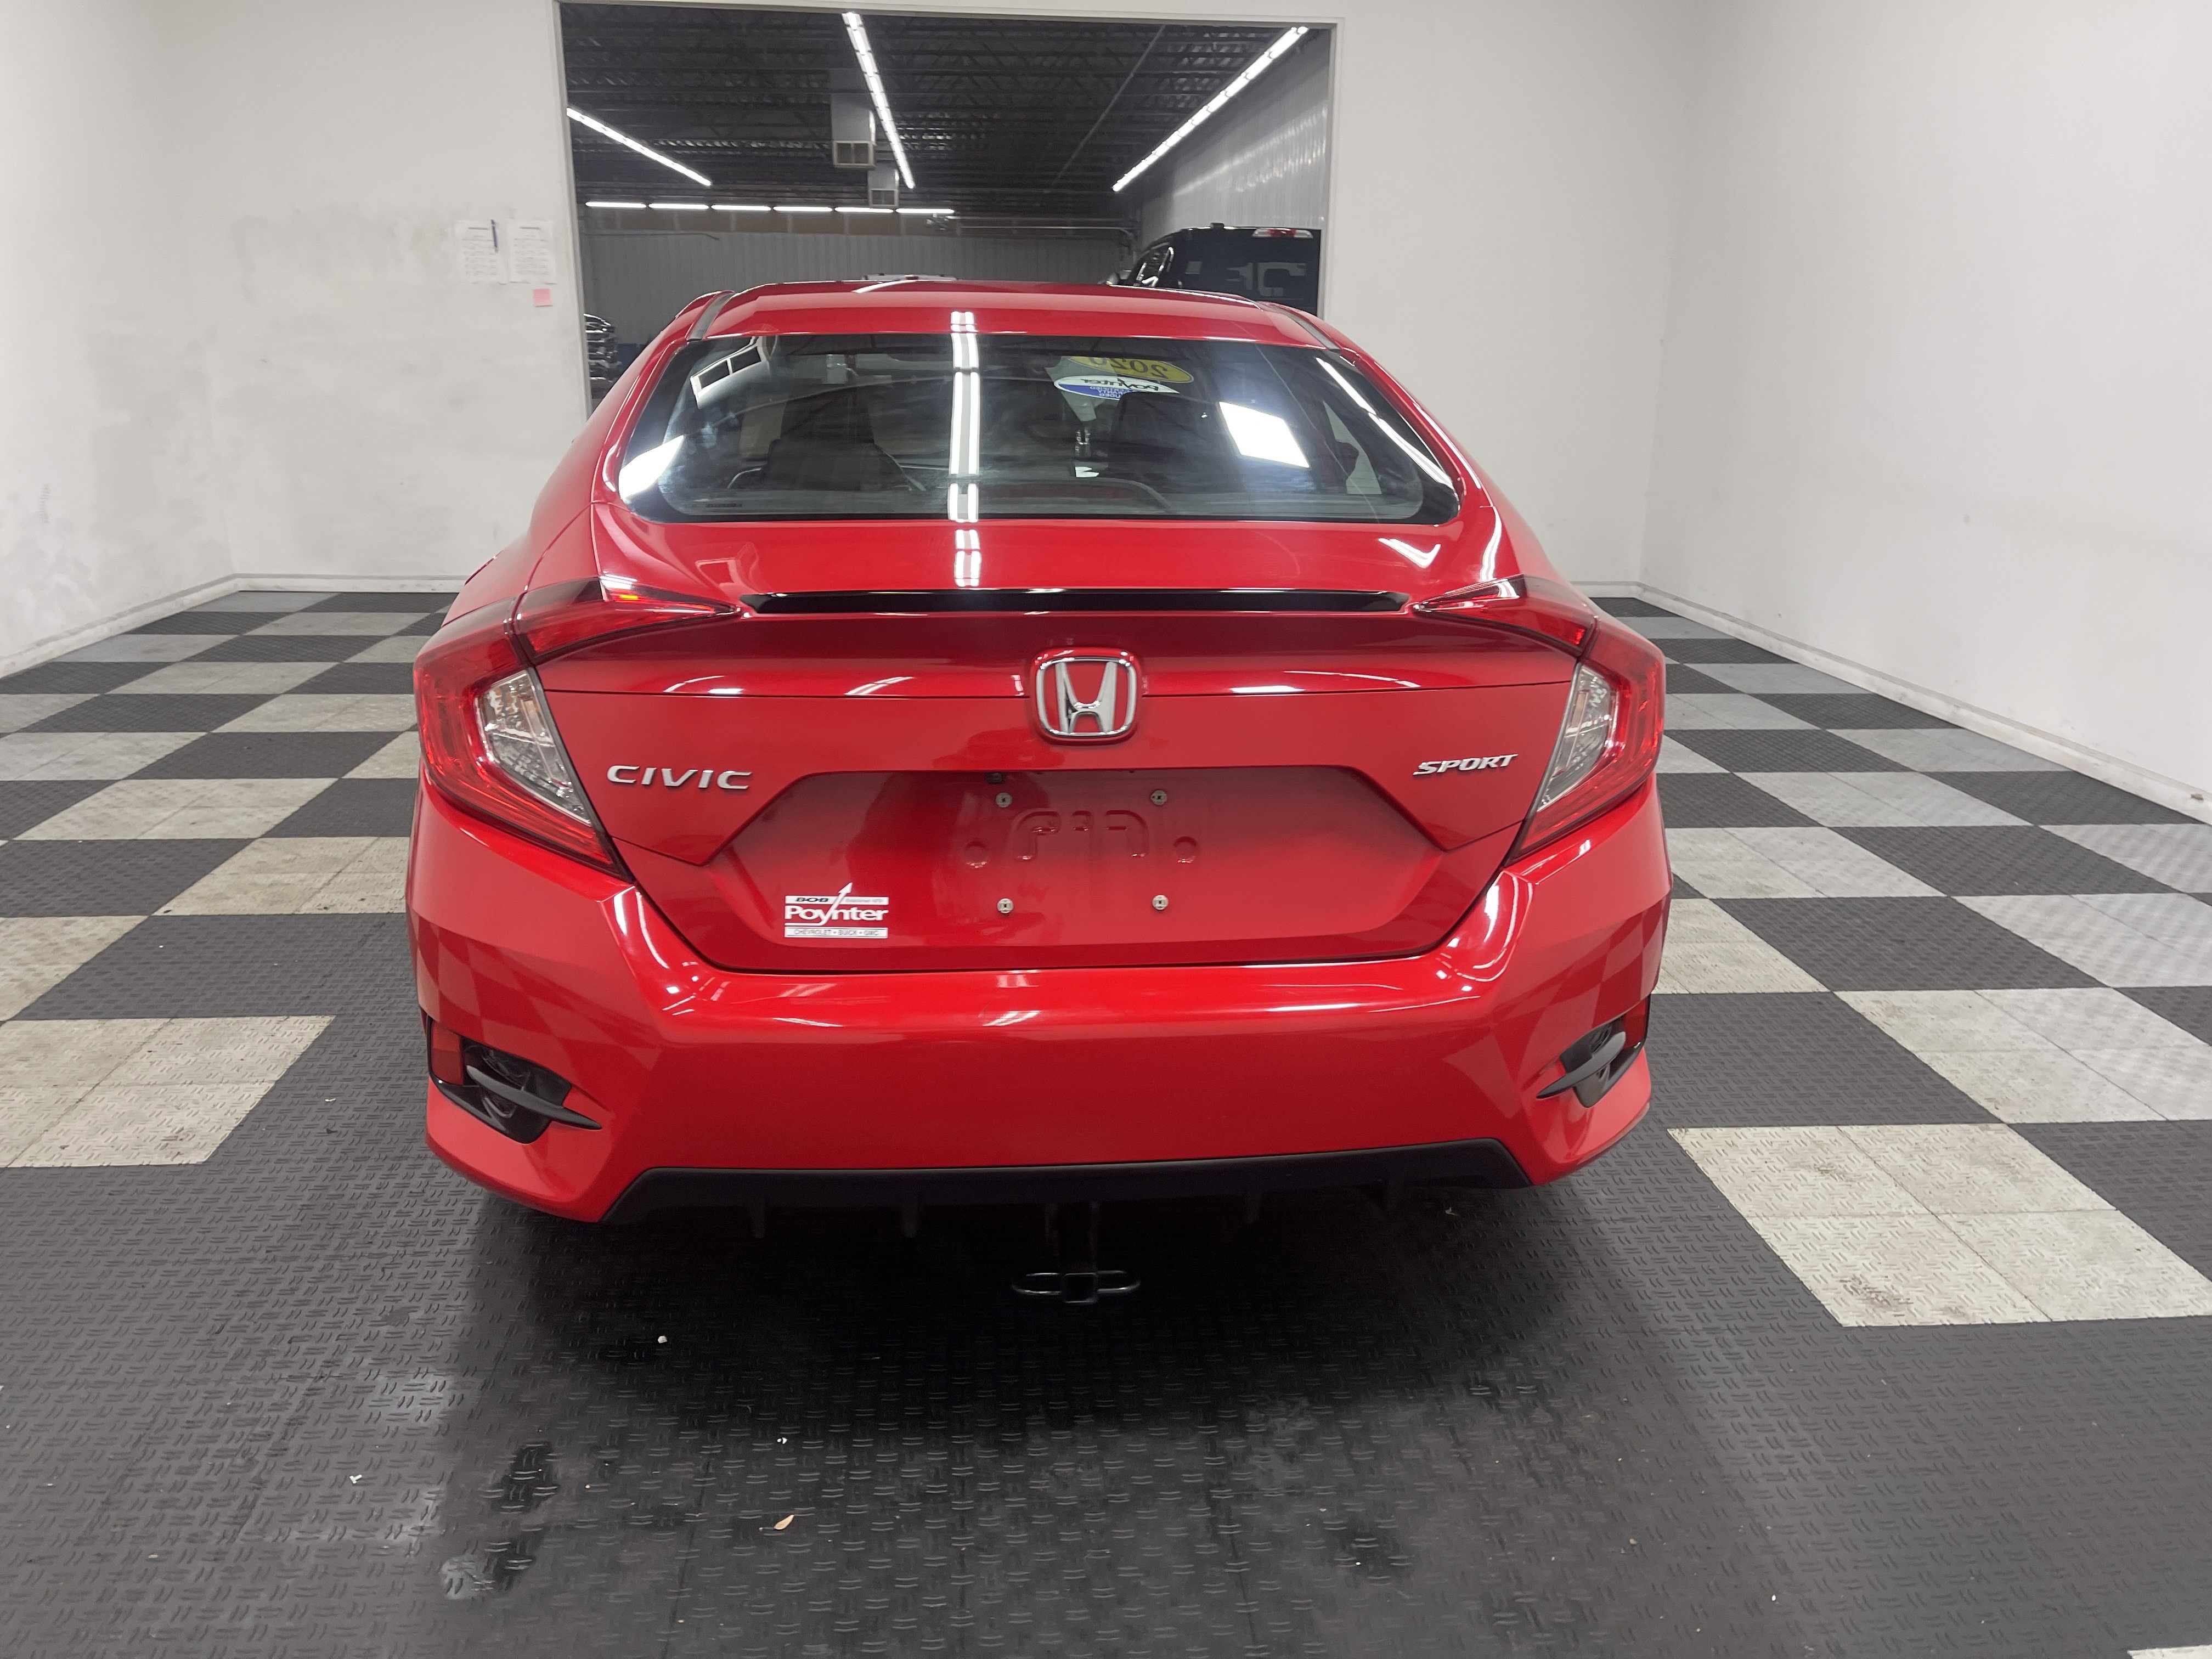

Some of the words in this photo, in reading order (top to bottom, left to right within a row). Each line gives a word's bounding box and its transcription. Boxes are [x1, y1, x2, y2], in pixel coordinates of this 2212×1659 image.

[1413, 753, 1519, 775] SPORT
[607, 765, 753, 789] CIVIC
[785, 905, 889, 923] Poynter
